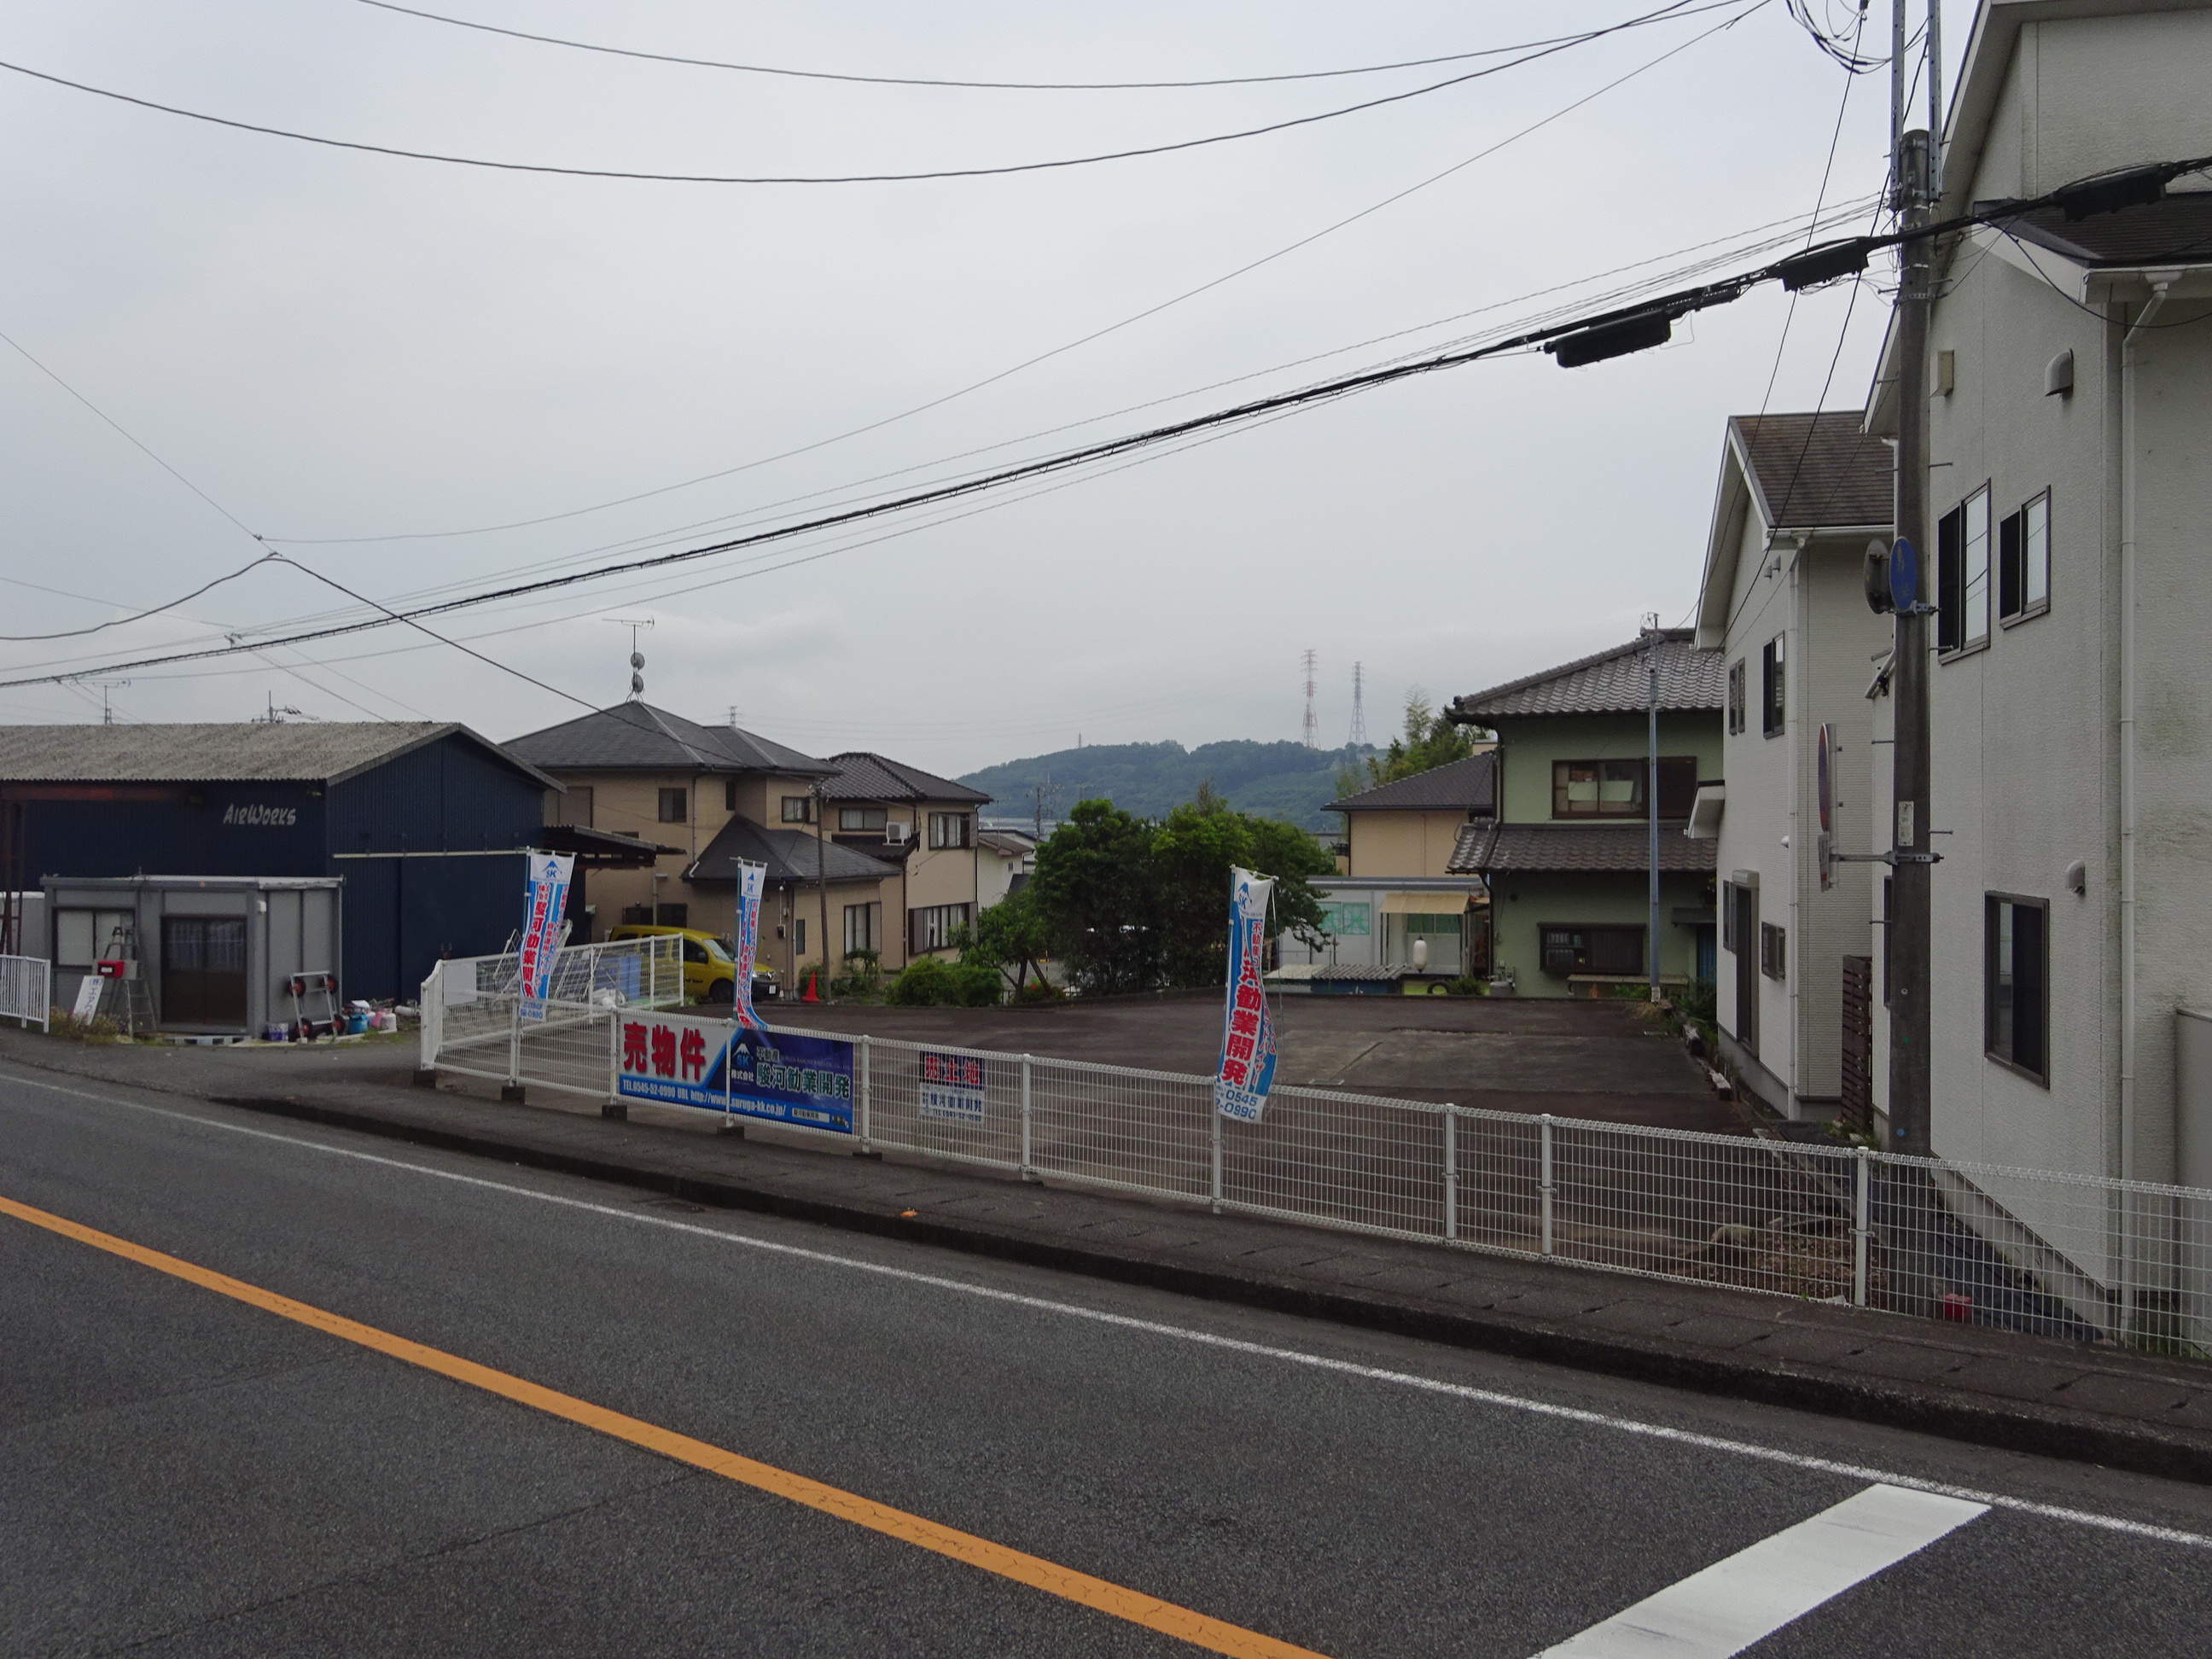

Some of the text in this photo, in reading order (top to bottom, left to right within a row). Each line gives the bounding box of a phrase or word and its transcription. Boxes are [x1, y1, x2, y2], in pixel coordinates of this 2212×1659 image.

[623, 1022, 706, 1081] 売物件
[736, 1055, 749, 1066] SK
[731, 1069, 754, 1081] 株式会社
[756, 1062, 851, 1100] 駿河勧業開発
[677, 1087, 689, 1100] URL
[1225, 1090, 1259, 1107] 0545
